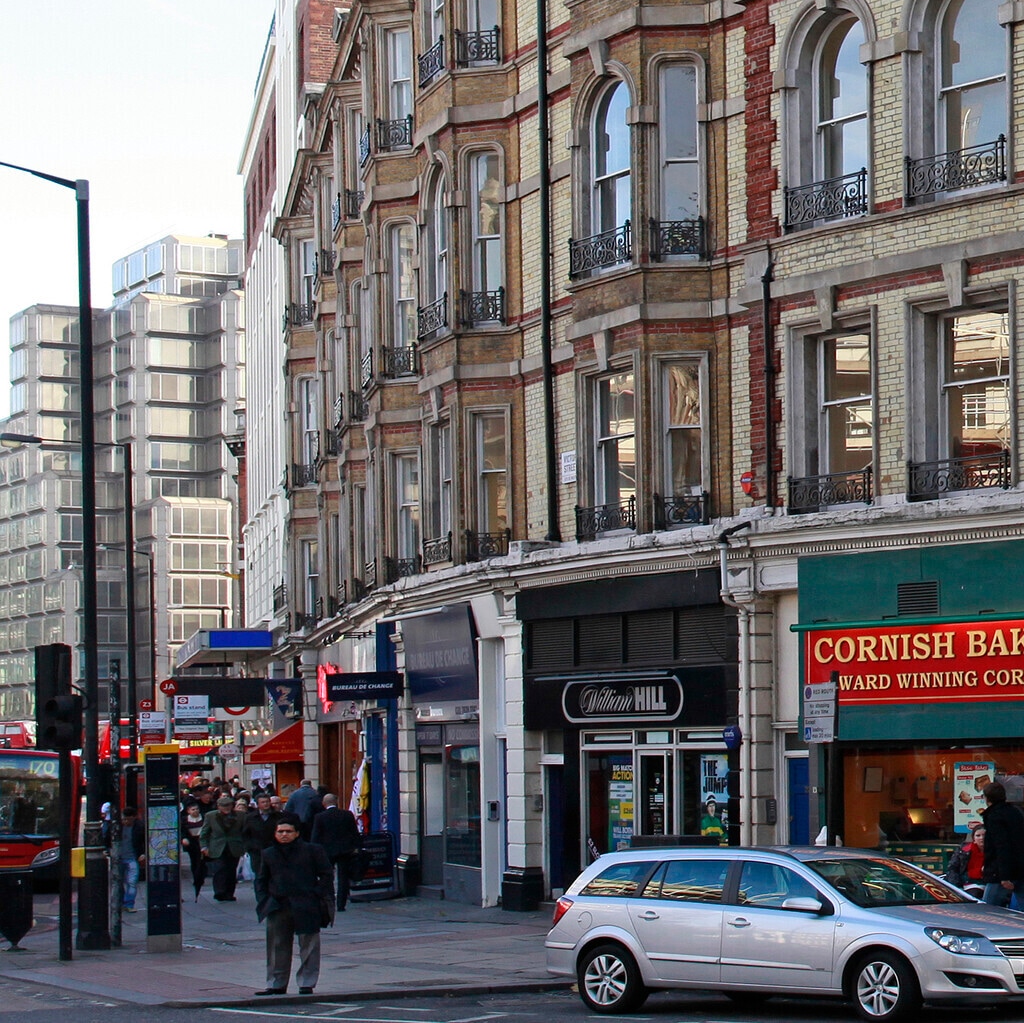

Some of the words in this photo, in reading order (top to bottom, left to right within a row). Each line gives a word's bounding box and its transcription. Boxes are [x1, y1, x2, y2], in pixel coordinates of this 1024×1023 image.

[814, 631, 955, 664] CORNISH
[838, 675, 891, 692] WARD
[896, 670, 978, 690] WINNING
[579, 684, 635, 714] William
[634, 686, 667, 711] HILL
[189, 739, 213, 747] SILVER
[29, 760, 55, 775] 170
[703, 759, 719, 777] THE
[703, 777, 728, 794] JUMP
